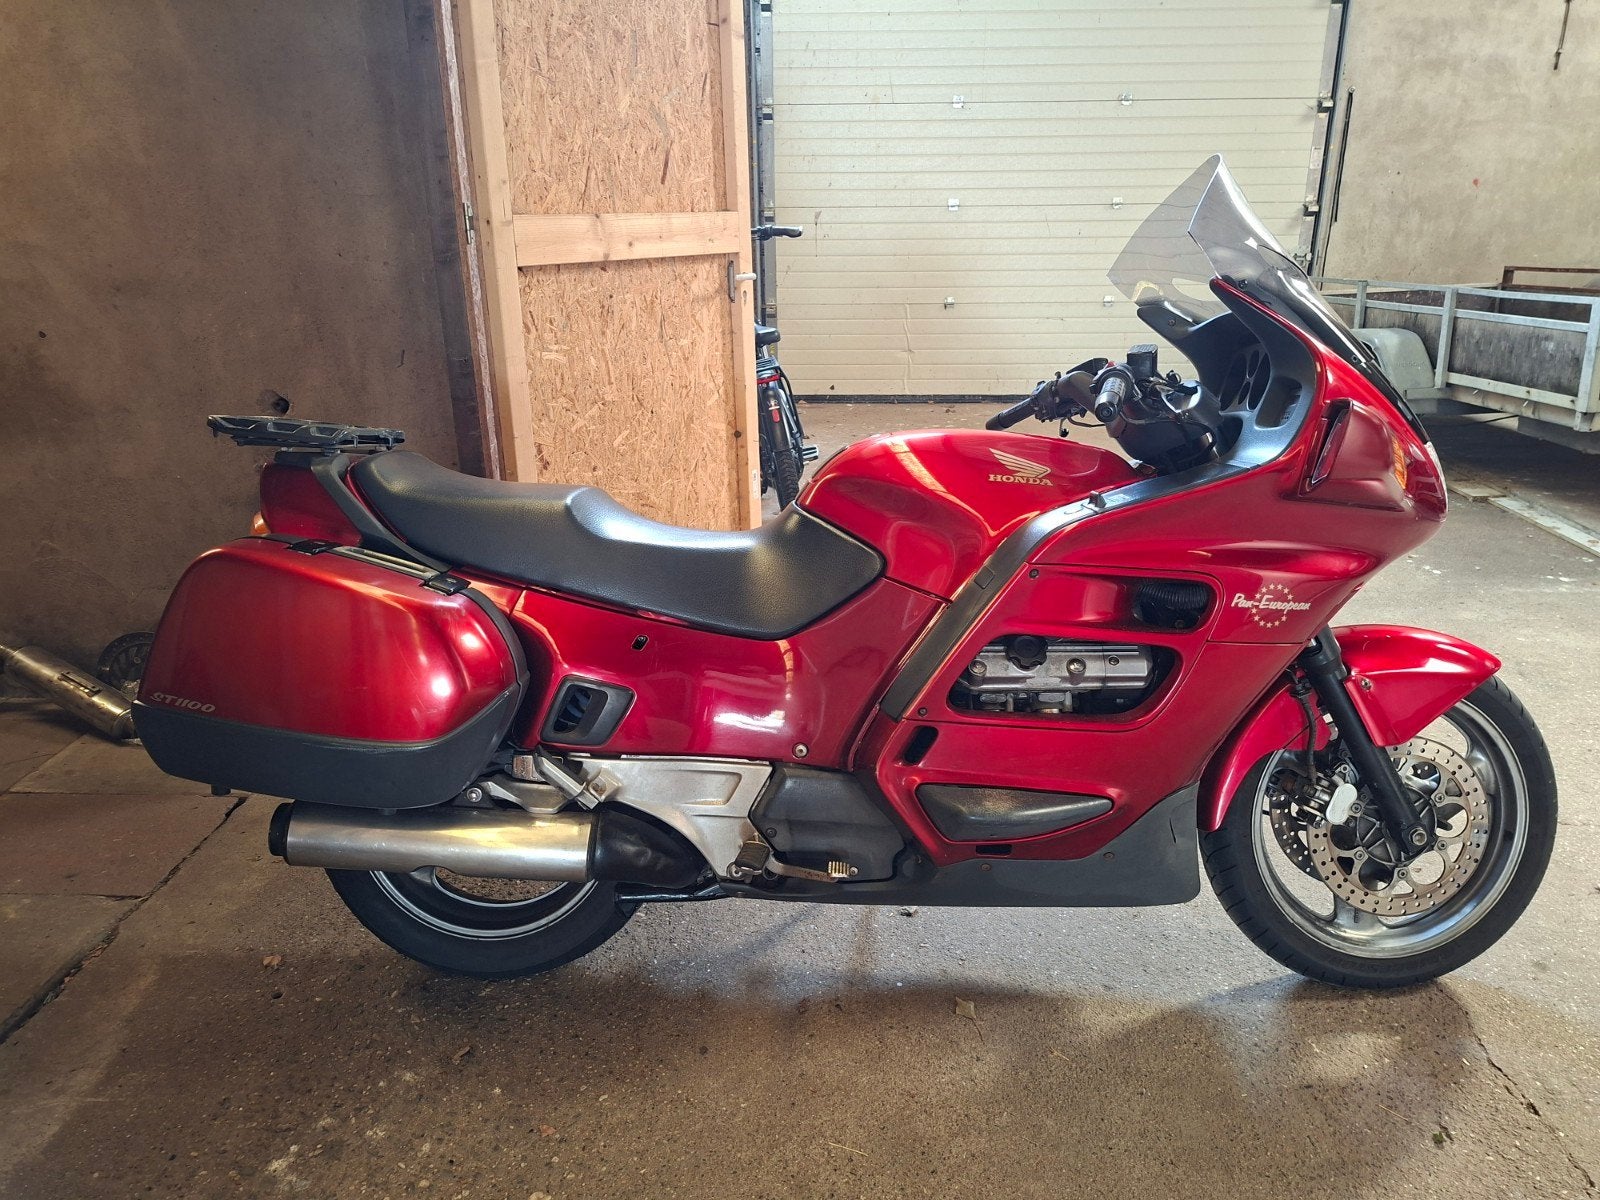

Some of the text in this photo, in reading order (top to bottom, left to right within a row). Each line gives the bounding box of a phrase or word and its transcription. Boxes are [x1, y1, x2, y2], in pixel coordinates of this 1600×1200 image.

[988, 474, 1053, 486] HONDA
[1231, 593, 1311, 614] Pan-European
[150, 692, 216, 713] ST1100
